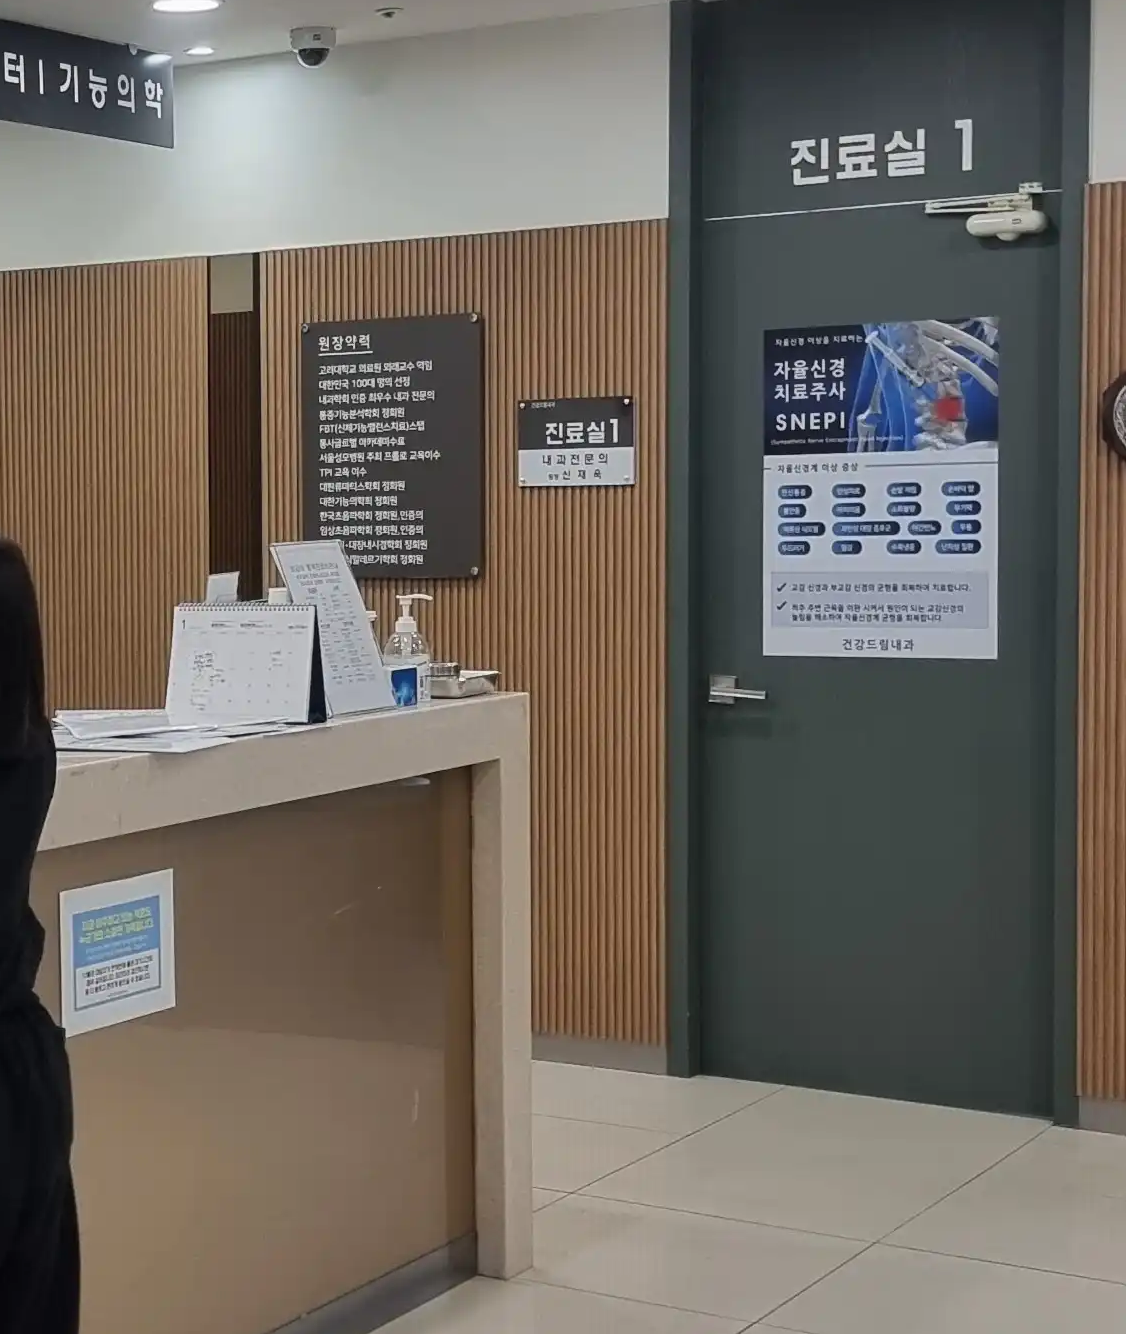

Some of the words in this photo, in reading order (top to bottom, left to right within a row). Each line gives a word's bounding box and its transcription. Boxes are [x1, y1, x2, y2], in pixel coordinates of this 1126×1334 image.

[59, 61, 164, 119] 기능의학
[790, 128, 925, 186] 진료실
[954, 118, 973, 171] 1
[318, 334, 370, 351] 원장약력
[773, 358, 845, 380] 자율신경
[318, 379, 349, 390] 대한민국
[352, 378, 375, 388] 100대
[394, 376, 410, 387] 선정
[393, 391, 409, 401] 내과
[774, 381, 846, 403] 치료주사
[381, 407, 405, 418] 정회원
[776, 411, 845, 431] SNEPI
[542, 453, 608, 466] 내과전문의
[351, 467, 368, 477] 이수
[562, 469, 602, 481] 신재욱
[842, 638, 914, 651] 건강드림내과
